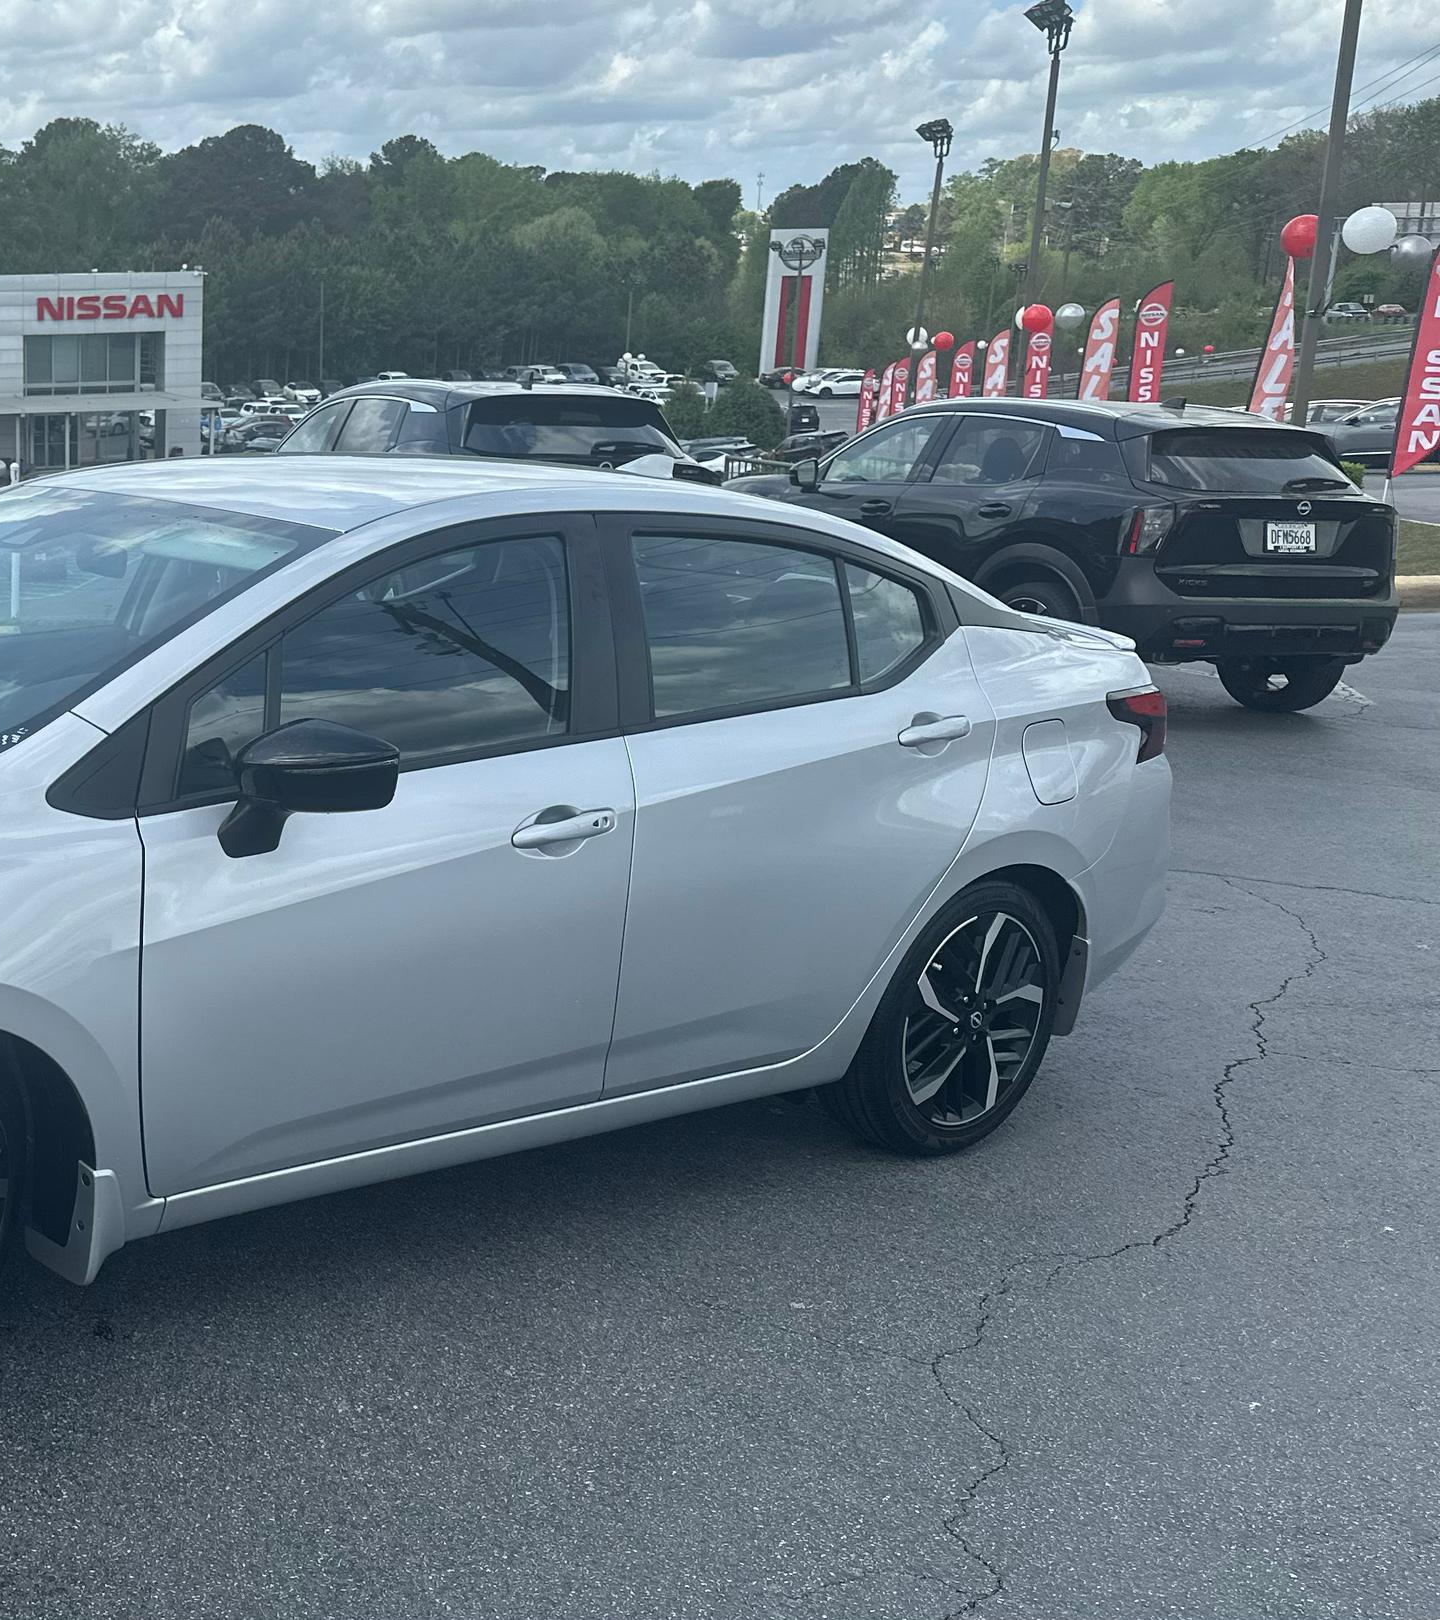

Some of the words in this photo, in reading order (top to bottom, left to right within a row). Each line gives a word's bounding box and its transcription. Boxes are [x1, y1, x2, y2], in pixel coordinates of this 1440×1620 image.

[36, 293, 184, 321] NISSAN
[955, 371, 969, 398] NI
[1271, 529, 1311, 545] DFM5668
